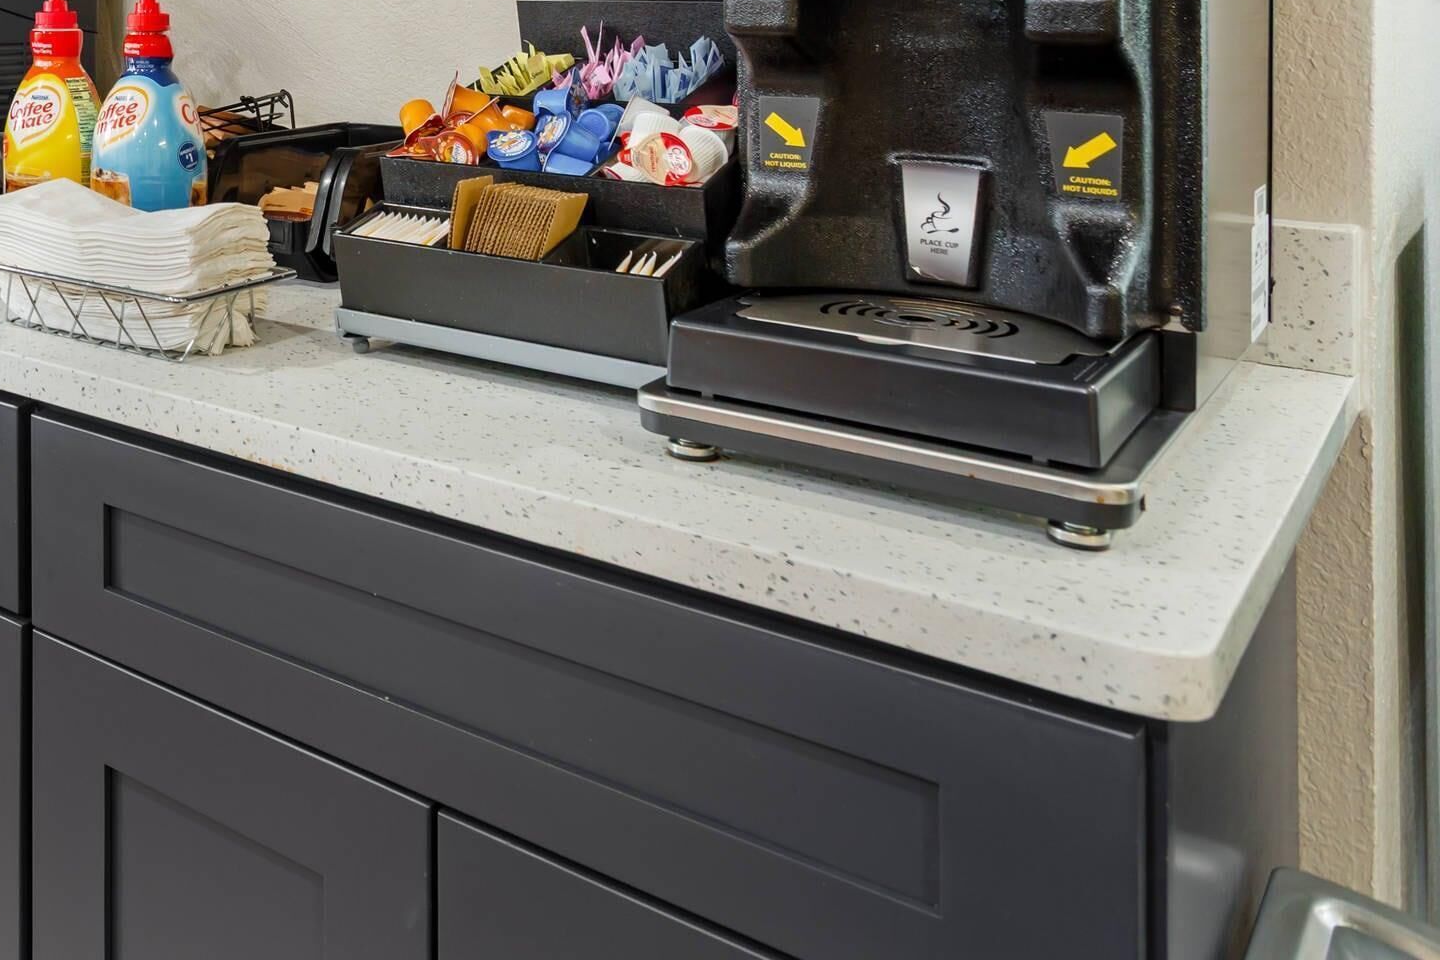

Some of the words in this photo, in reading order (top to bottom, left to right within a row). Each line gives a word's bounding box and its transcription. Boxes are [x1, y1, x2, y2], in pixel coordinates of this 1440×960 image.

[10, 100, 54, 119] Coffee
[98, 102, 138, 121] offee
[780, 161, 807, 169] LIQUIDS
[1063, 184, 1081, 192] HOT
[1082, 186, 1118, 196] LIQUIDS
[920, 238, 941, 247] PLACE
[930, 247, 948, 255] HERE
